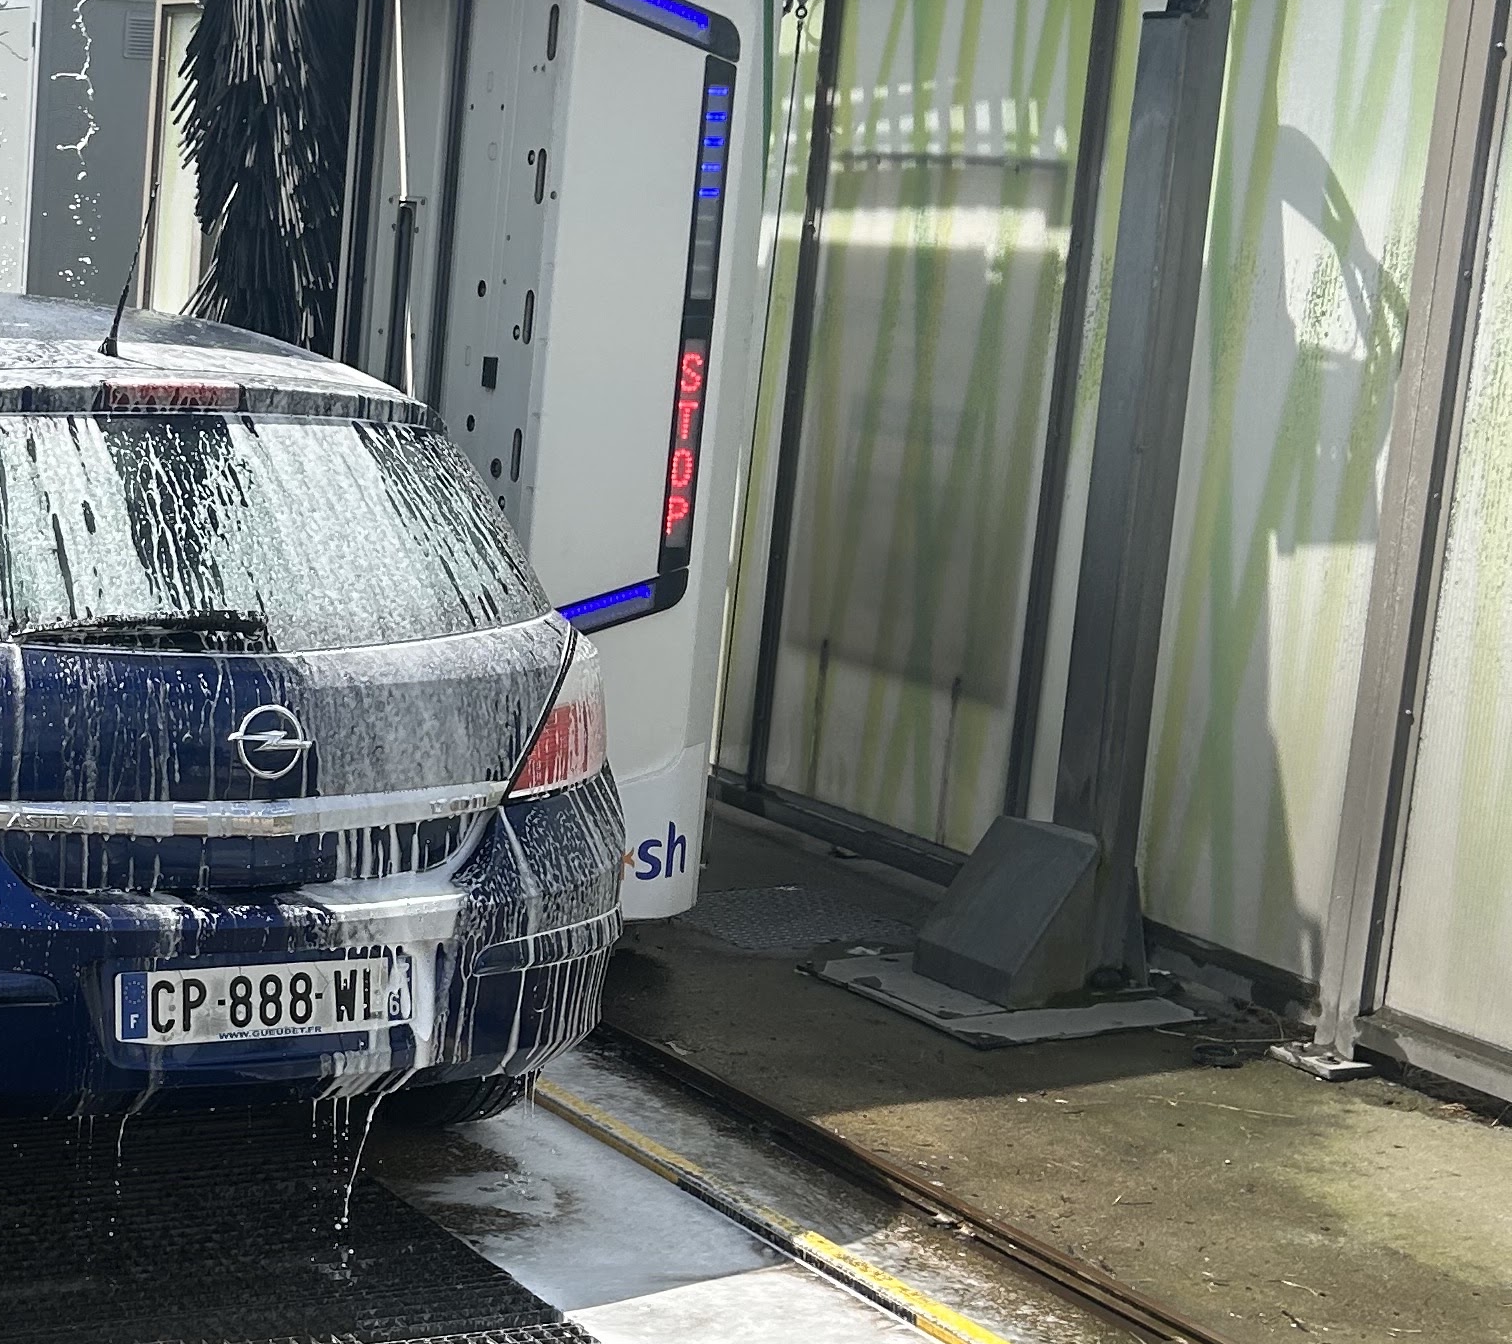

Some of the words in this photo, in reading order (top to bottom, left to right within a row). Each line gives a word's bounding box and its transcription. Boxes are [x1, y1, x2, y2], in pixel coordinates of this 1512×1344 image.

[665, 352, 704, 536] STOP
[6, 812, 88, 830] ASTRA
[618, 820, 687, 881] sh
[129, 1013, 140, 1029] F
